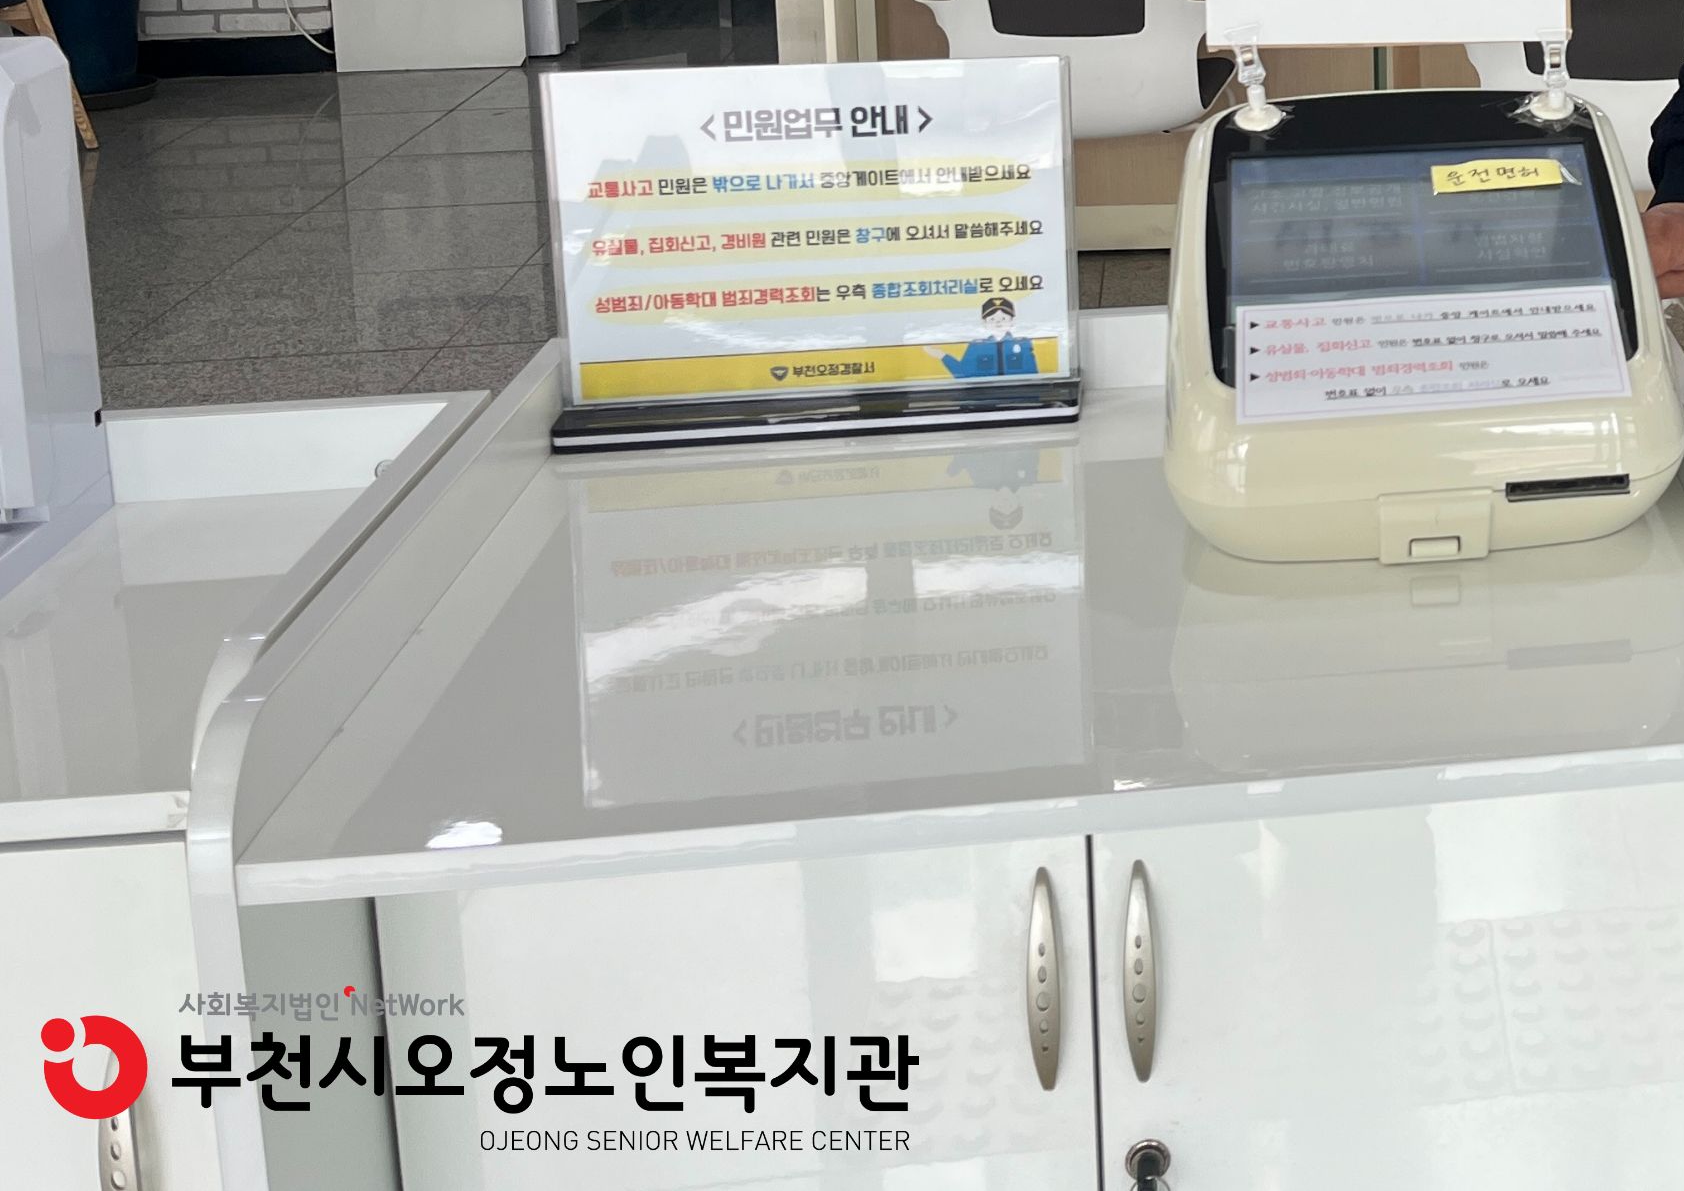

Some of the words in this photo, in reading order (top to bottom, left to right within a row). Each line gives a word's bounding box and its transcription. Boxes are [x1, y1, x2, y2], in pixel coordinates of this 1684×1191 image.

[723, 108, 843, 142] 민원업무
[850, 105, 909, 137] 안내
[588, 180, 653, 198] 교통사고
[658, 177, 707, 195] 민원은
[713, 175, 762, 193] 밖으로
[766, 173, 814, 191] 나가서
[820, 170, 931, 189] 중앙게이트에서
[936, 163, 1031, 184] 안내받으세요
[1447, 166, 1540, 186] 운전면허
[592, 239, 644, 256] 유실물,
[649, 235, 716, 253] 집회신고,
[721, 233, 766, 250] 경비원
[771, 231, 801, 247] 관련
[806, 228, 850, 245] 민원은
[856, 226, 900, 244] 창구에
[906, 223, 949, 241] 오셔서
[954, 220, 1043, 239] 말씀해주세요
[595, 291, 717, 314] 성범죄/아동학대
[722, 286, 831, 307] 범죄경력조회는
[836, 283, 867, 301] 우측
[872, 277, 993, 298] 종합조회처리실로
[998, 275, 1044, 293] 오세요
[1264, 317, 1327, 330] 교통사고
[1317, 339, 1373, 352] 집회신고
[793, 362, 875, 377] 부천오정경찰서
